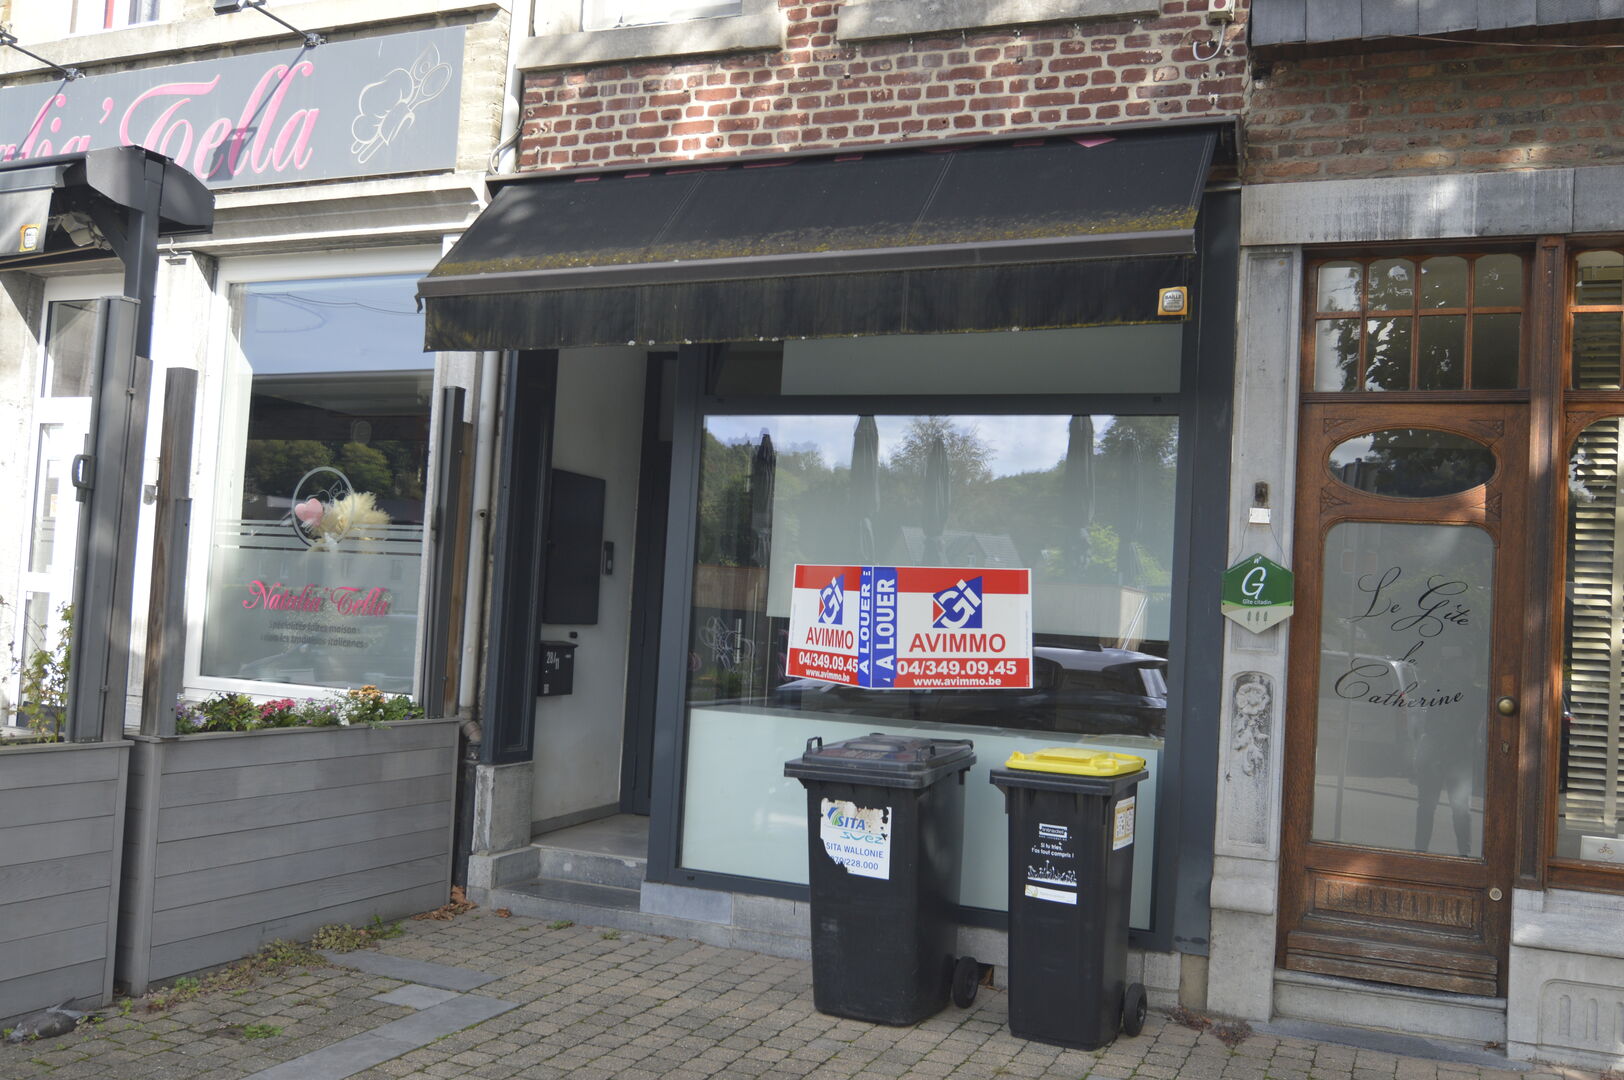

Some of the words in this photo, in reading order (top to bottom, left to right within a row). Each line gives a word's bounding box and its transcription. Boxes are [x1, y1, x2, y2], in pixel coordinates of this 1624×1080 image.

[119, 61, 320, 181] Tella
[330, 586, 389, 617] Tella
[1347, 566, 1401, 624] Le
[860, 583, 871, 654] LOUER
[876, 578, 895, 649] LOUER
[805, 625, 854, 650] AVIMMO
[909, 632, 1007, 653] AVIMMO
[798, 650, 859, 673] 04/349.09.45
[875, 654, 895, 671] A
[896, 660, 1017, 676] 04/349.09.45
[805, 667, 851, 683] www.avimmo.be
[913, 676, 1002, 687] www.avimmo.be
[1335, 657, 1464, 708] Catherine
[837, 815, 866, 831] SITA
[826, 842, 842, 851] SITA
[844, 845, 884, 858] WALLONIE
